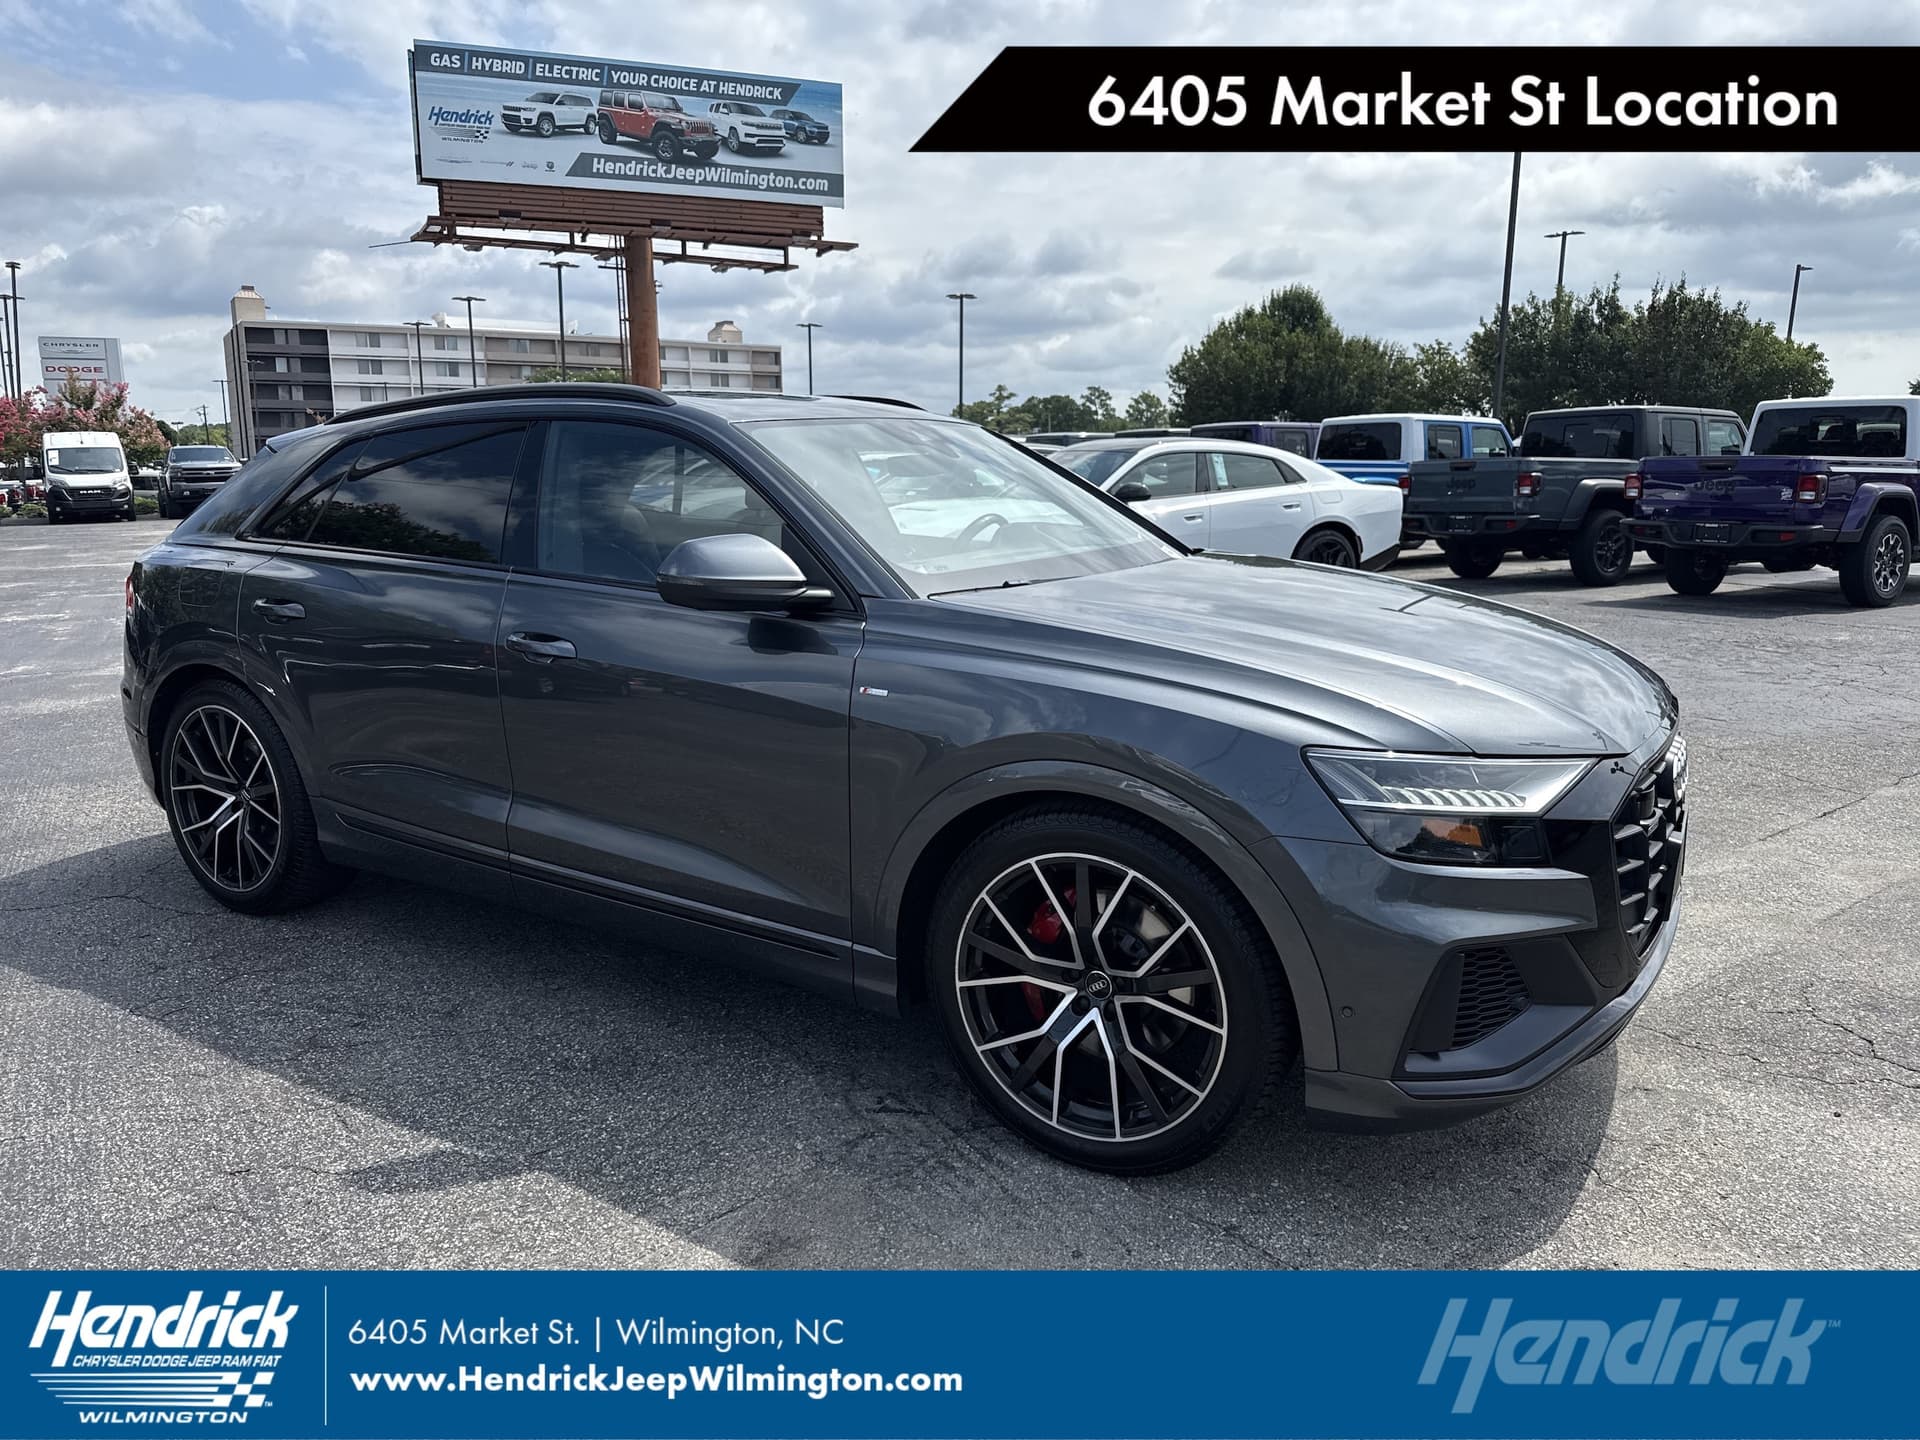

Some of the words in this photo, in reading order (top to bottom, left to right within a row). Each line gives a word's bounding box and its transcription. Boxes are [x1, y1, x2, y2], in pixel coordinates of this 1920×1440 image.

[430, 53, 461, 68] GAS
[471, 56, 525, 75] HYBRID
[535, 63, 601, 82] ELECTRIC
[610, 70, 648, 87] YOUR
[650, 74, 698, 92] CHOICE
[700, 79, 717, 93] AT
[718, 82, 783, 100] HENDRICK
[428, 106, 494, 126] Hendrick
[592, 157, 829, 191] HendrickJeepWilmington.com
[1694, 480, 1736, 495] Jeep
